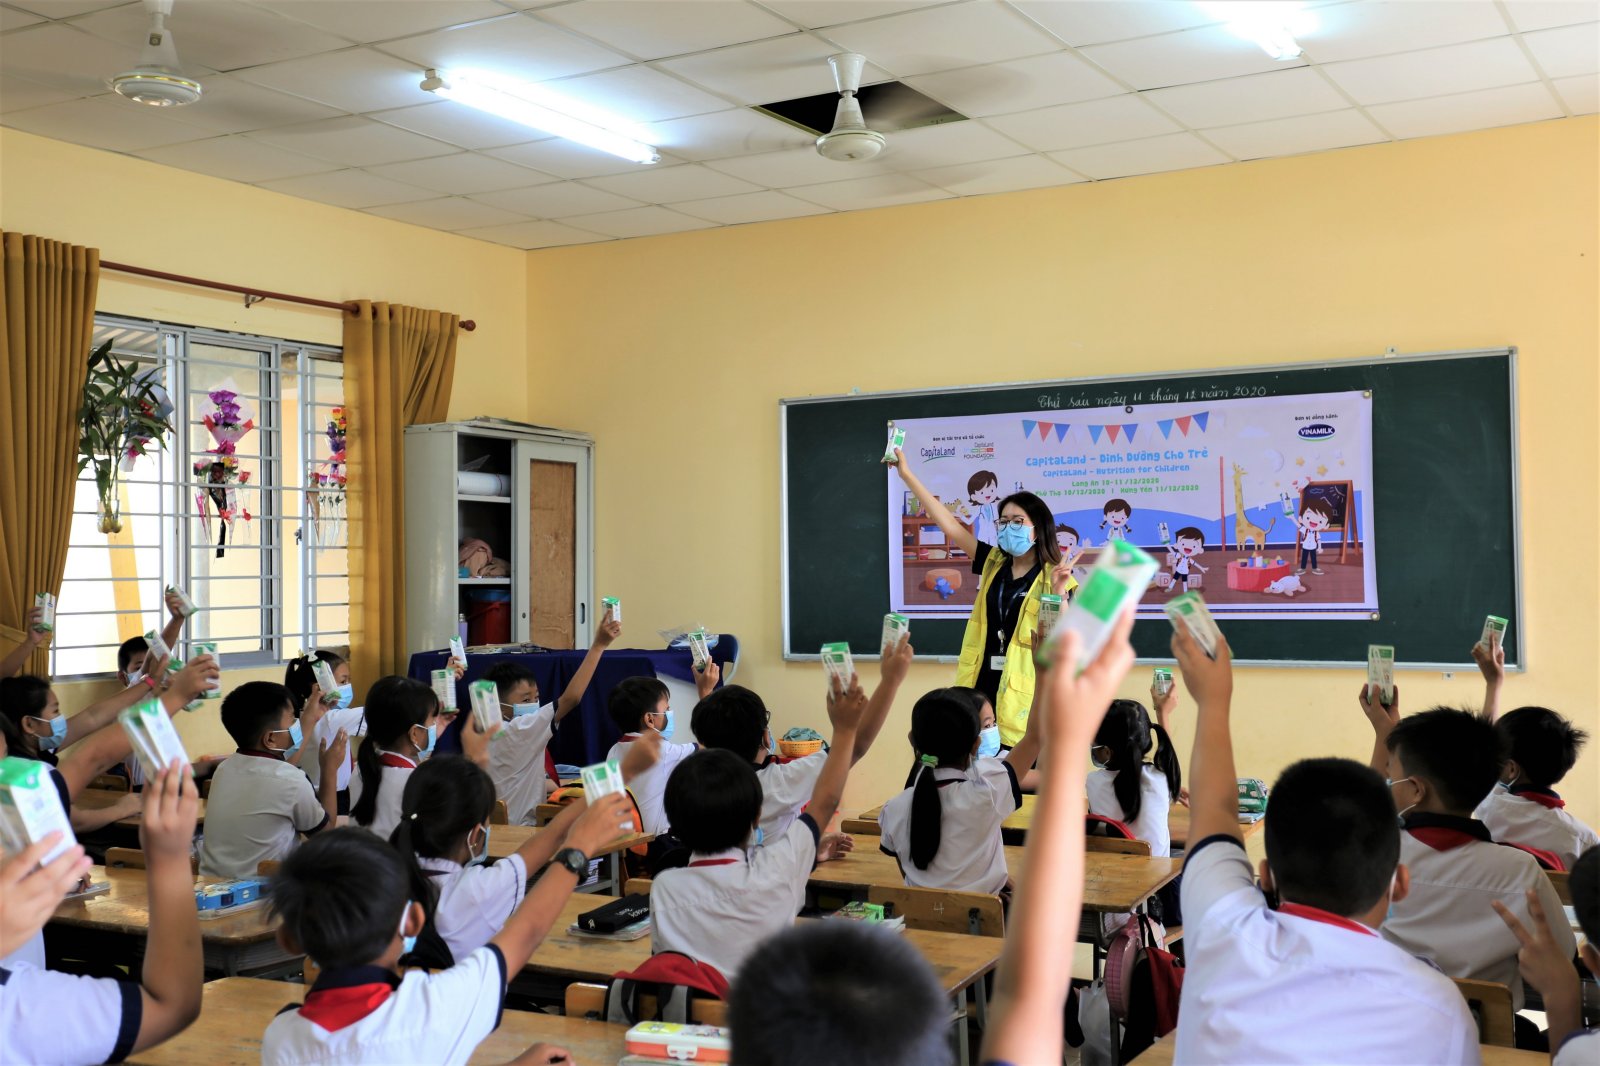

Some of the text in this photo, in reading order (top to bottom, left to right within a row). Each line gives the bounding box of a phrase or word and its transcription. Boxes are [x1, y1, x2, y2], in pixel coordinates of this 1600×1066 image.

[1067, 392, 1089, 407] sáu
[1133, 392, 1142, 401] 11
[1150, 387, 1179, 403] tháng
[1185, 389, 1196, 399] 12
[1201, 385, 1229, 398] năm
[1233, 386, 1267, 397] 2020
[1025, 455, 1086, 467] CapitaLand
[1100, 453, 1123, 463] Dinh
[1127, 450, 1160, 462] Dưỡng
[1164, 450, 1184, 460] Cho
[1187, 446, 1208, 459] Trẻ
[1042, 468, 1087, 478] CapitaLand
[1096, 466, 1135, 475] Nutrition
[1138, 465, 1152, 473] for
[1154, 464, 1190, 473] Children
[1156, 484, 1200, 493] 11/12/2020
